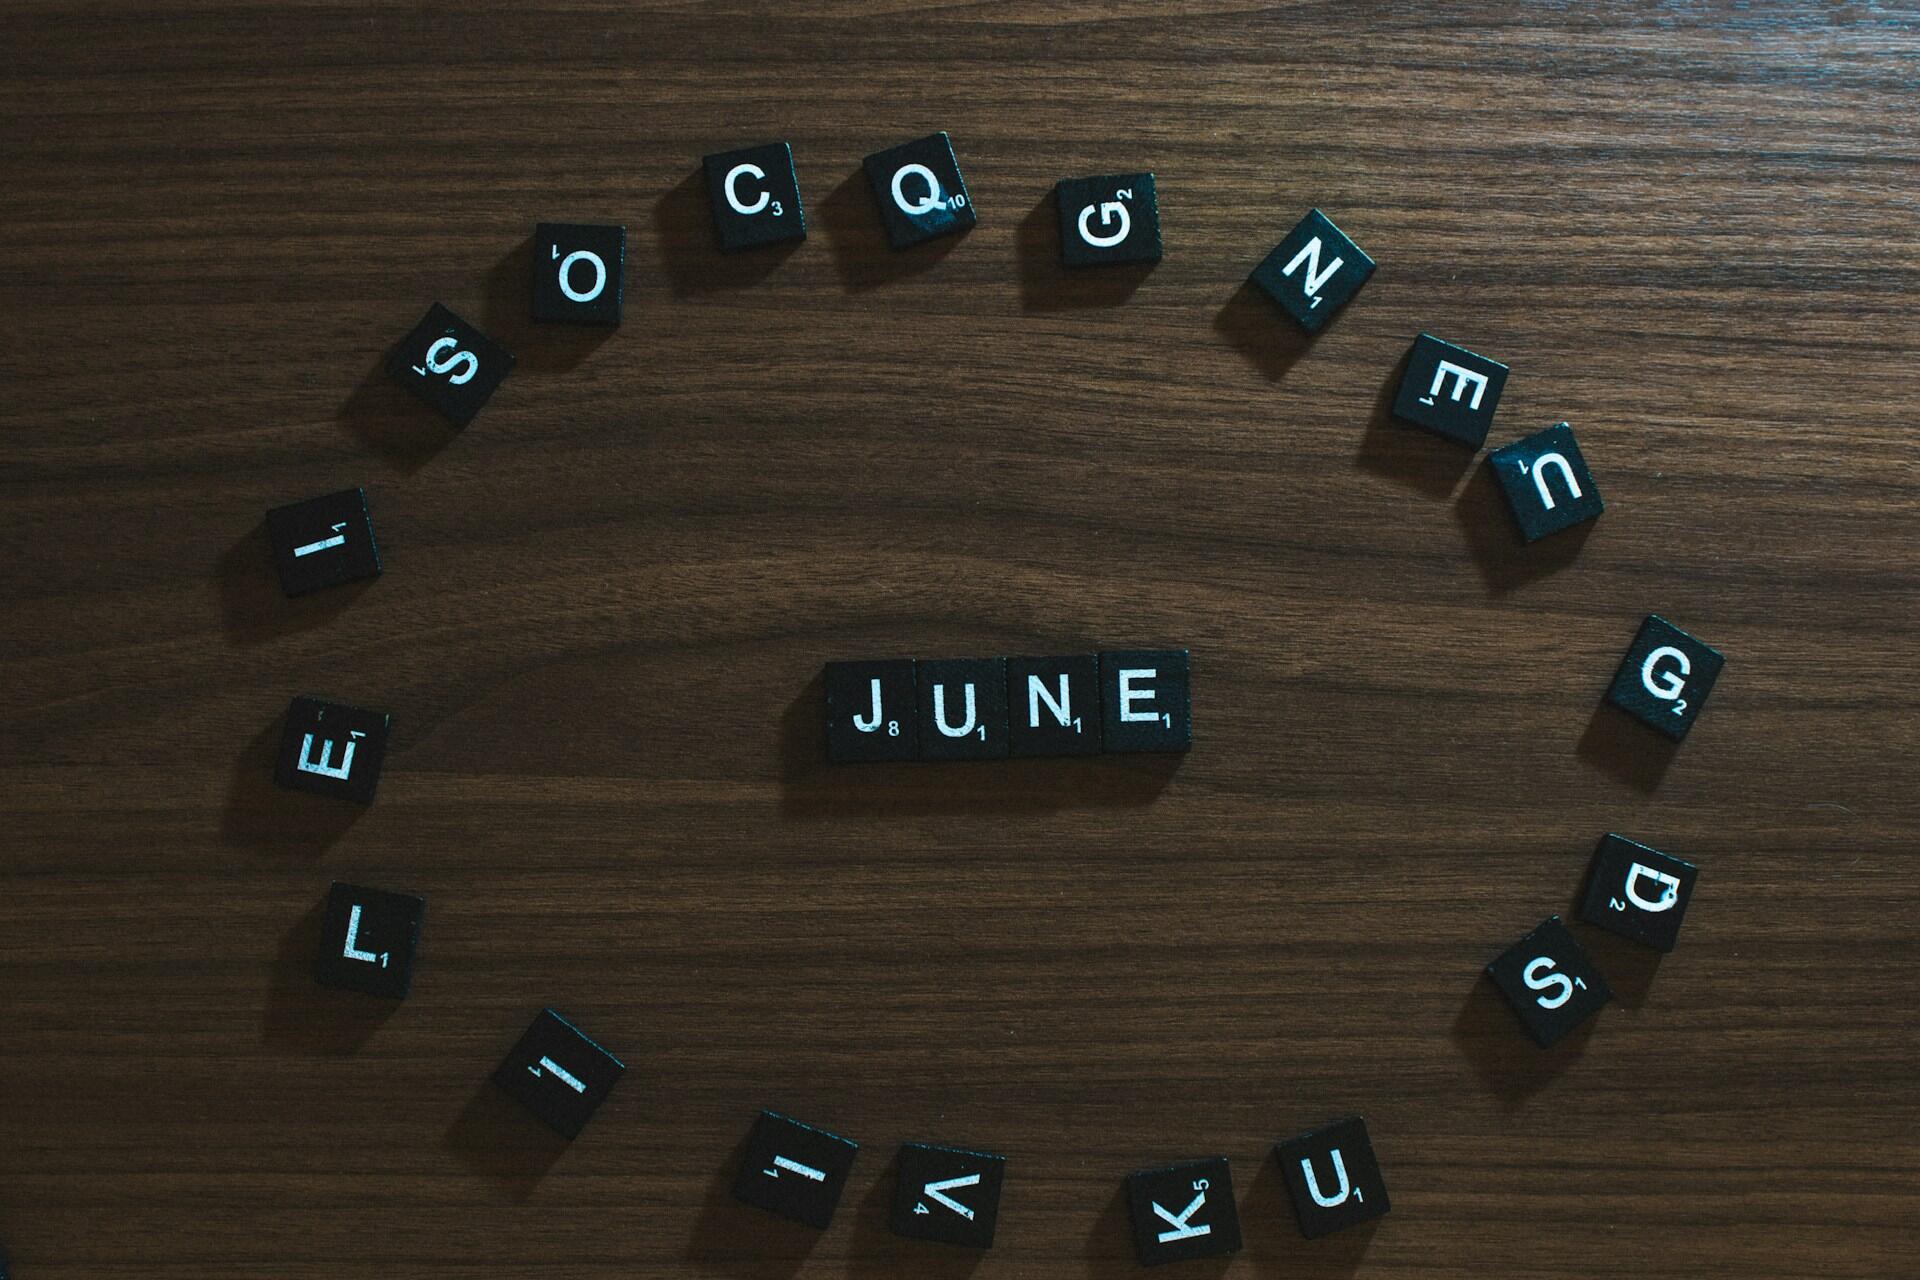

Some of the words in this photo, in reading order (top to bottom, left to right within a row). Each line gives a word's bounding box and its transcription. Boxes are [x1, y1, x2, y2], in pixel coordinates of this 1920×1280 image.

[724, 163, 770, 214] C
[771, 200, 784, 217] 3
[891, 163, 947, 215] Q
[947, 193, 968, 210] 10
[1078, 201, 1131, 248] G
[1115, 188, 1133, 200] 2
[552, 244, 561, 260] 1
[557, 250, 607, 303] O
[1282, 236, 1345, 297] N
[1309, 296, 1323, 309] 1
[412, 363, 428, 378] 1
[424, 336, 479, 386] S
[1429, 359, 1490, 410] E
[1418, 397, 1435, 408] 1
[1518, 458, 1530, 476] 1
[1532, 452, 1584, 511] U
[294, 534, 346, 558] I
[331, 522, 347, 535] 1
[1642, 646, 1692, 701] G
[1672, 698, 1689, 717] 2
[888, 719, 902, 738] 8
[976, 724, 988, 743] 1
[1072, 716, 1084, 735] 1
[1161, 712, 1173, 730] 1
[297, 738, 357, 781] E
[349, 730, 366, 741] 1
[1608, 896, 1627, 913] 2
[1625, 862, 1682, 913] D
[342, 905, 376, 964] L
[379, 952, 390, 969] 1
[1522, 957, 1573, 1010] S
[1573, 976, 1588, 991] 1
[527, 1063, 543, 1079] 1
[538, 1055, 587, 1094] I
[762, 1167, 779, 1181] 1
[774, 1155, 827, 1183] I
[1301, 1149, 1350, 1208] U
[1350, 1186, 1365, 1204] 1
[913, 1201, 931, 1216] 4
[924, 1174, 980, 1218] V
[1153, 1191, 1212, 1243] K
[1191, 1178, 1211, 1191] 5
